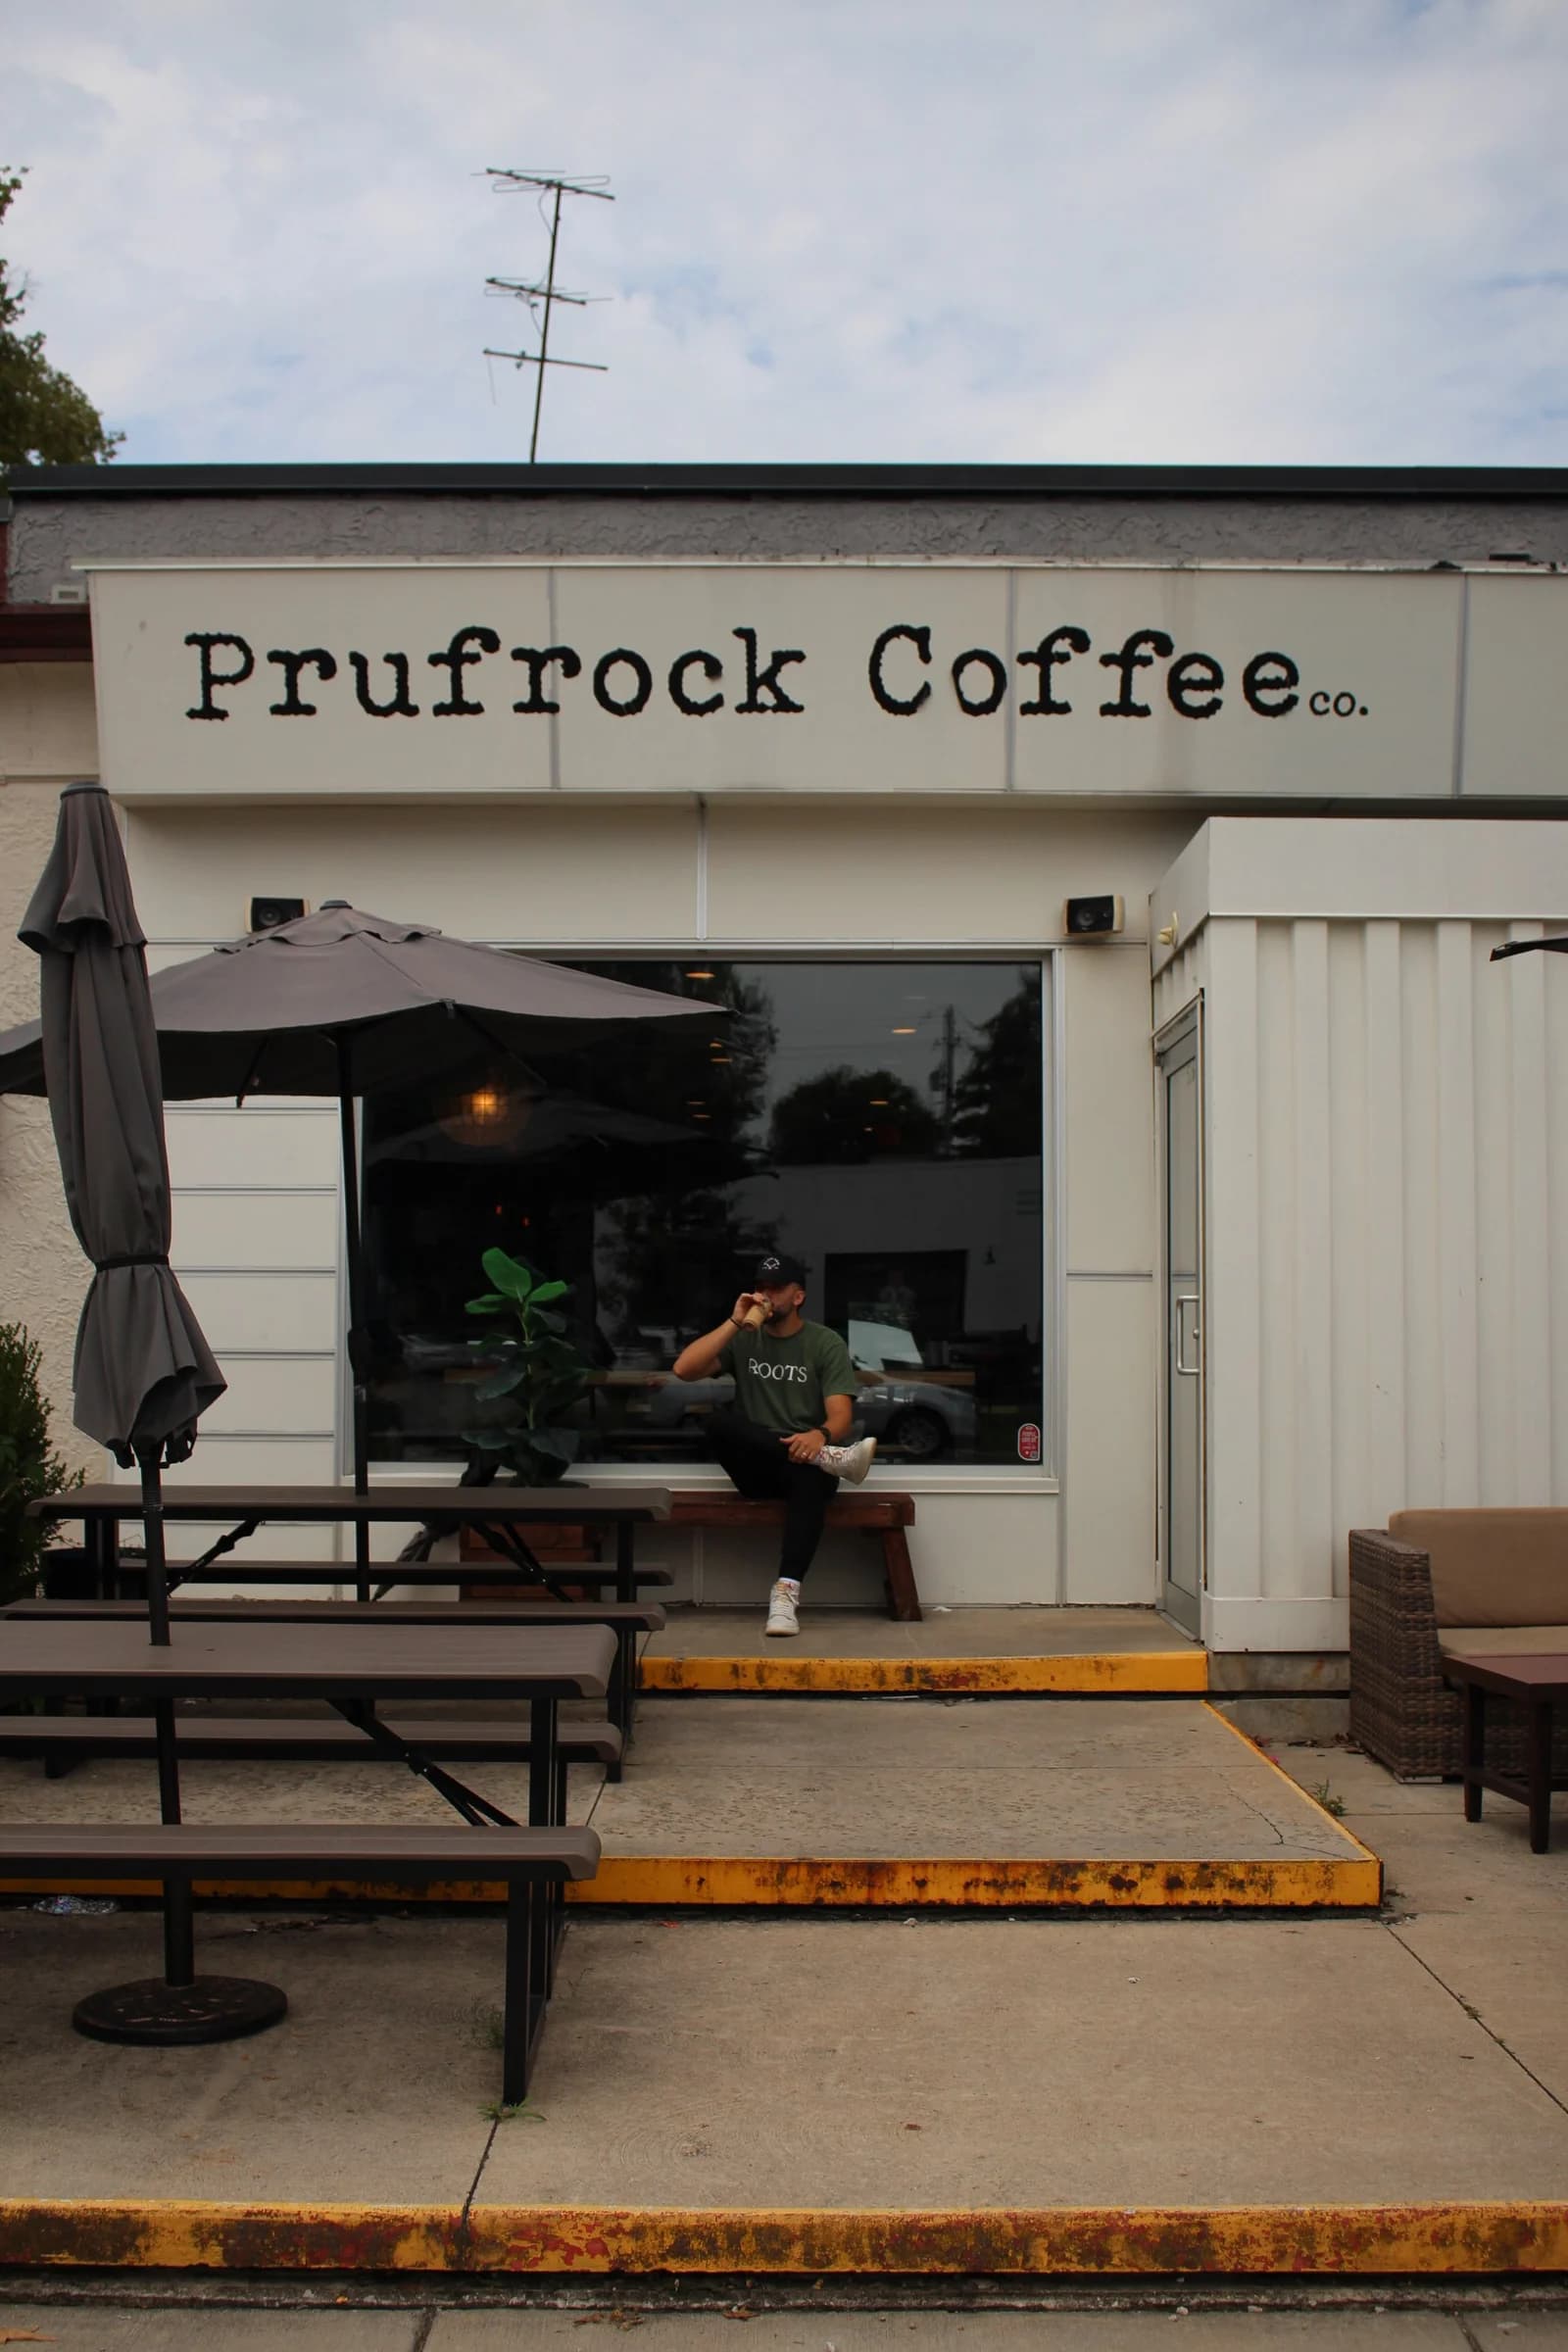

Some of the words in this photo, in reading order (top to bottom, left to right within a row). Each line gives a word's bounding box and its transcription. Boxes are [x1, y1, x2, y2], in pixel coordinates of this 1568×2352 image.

[184, 626, 806, 720] Prufrock
[869, 624, 1299, 719] Coffee
[749, 1358, 808, 1383] ROOTS
